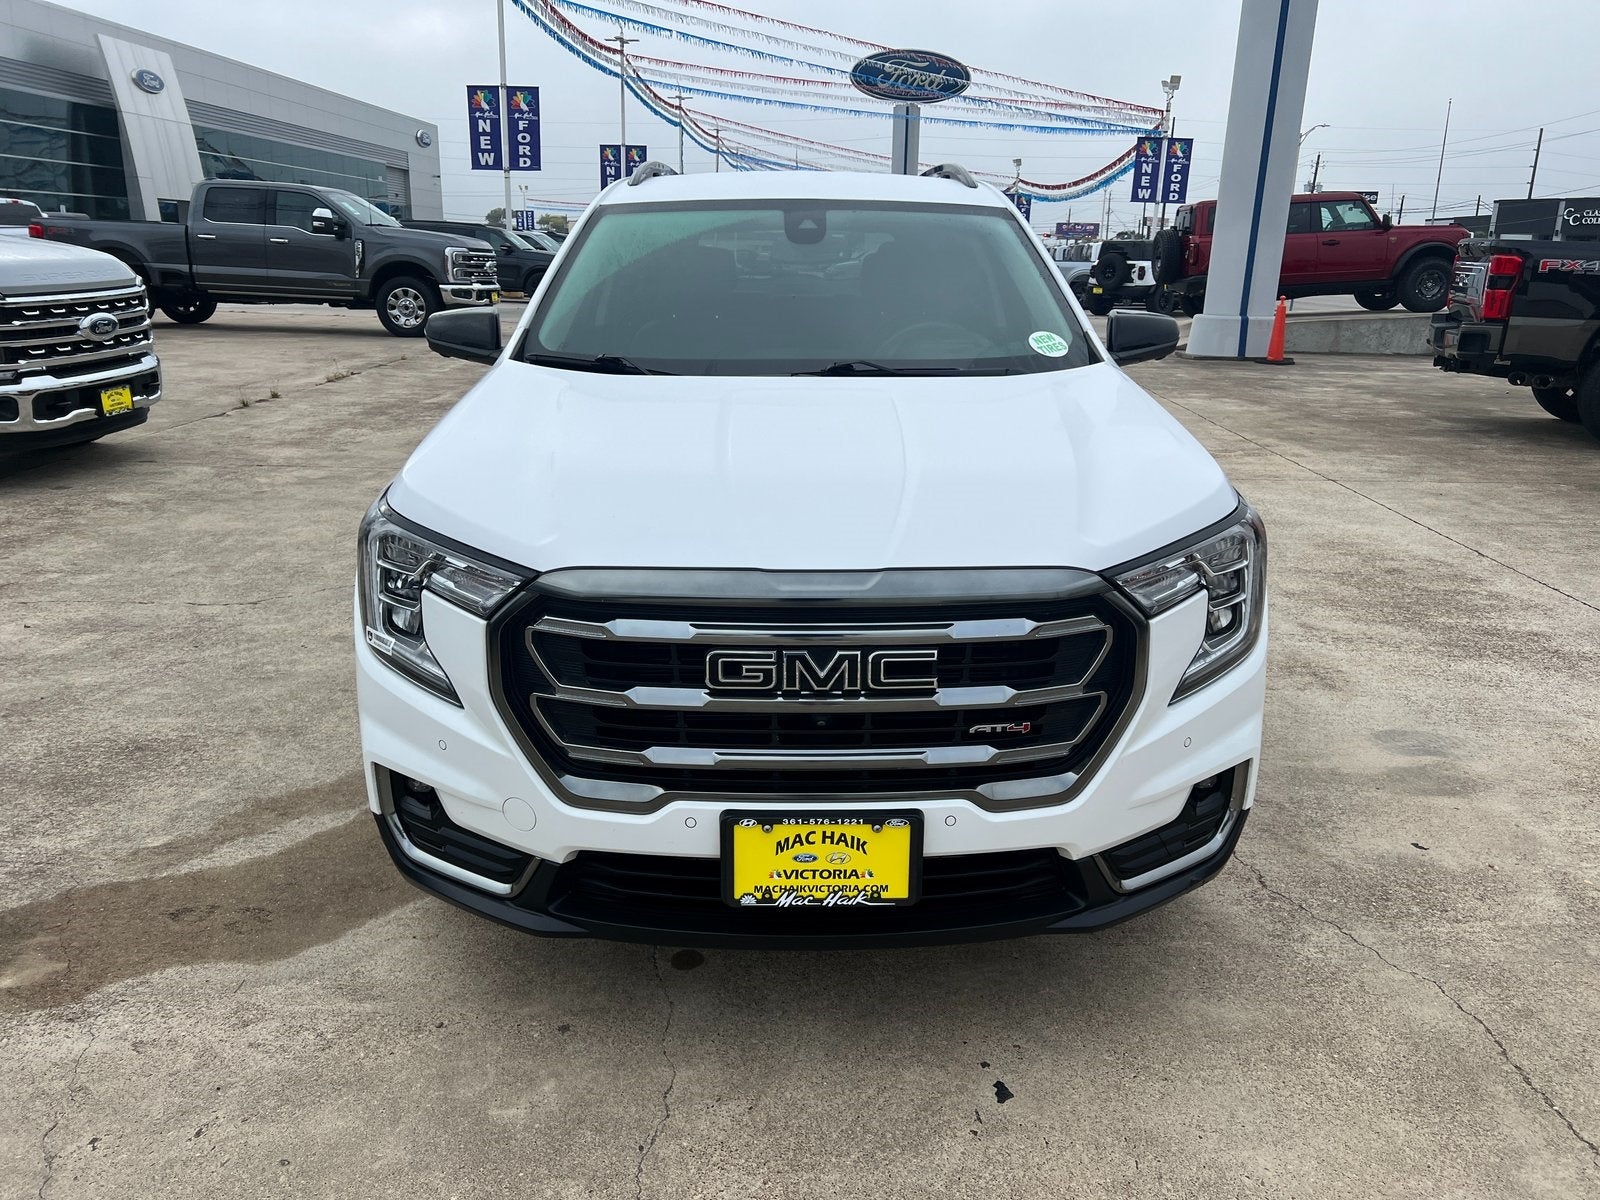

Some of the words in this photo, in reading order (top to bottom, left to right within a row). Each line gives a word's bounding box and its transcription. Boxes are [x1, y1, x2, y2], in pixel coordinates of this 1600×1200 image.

[877, 59, 947, 92] Ford
[478, 119, 495, 166] NEW
[517, 120, 531, 168] FORD
[606, 166, 616, 185] NE
[1137, 162, 1153, 200] NEW
[1168, 164, 1183, 201] FORD
[1538, 258, 1600, 274] FX4
[1032, 333, 1056, 346] NEW
[1037, 342, 1068, 355] TIRES
[705, 650, 938, 691] GMC
[969, 722, 1031, 734] AT4
[782, 818, 864, 826] 361-576-1221
[775, 830, 817, 856] MAC
[821, 830, 868, 856] HAIK
[783, 869, 861, 880] VICTORIA
[753, 884, 889, 894] MACHAIKVICTORIA.COM
[776, 890, 816, 908] Mac
[821, 890, 869, 908] Haik
